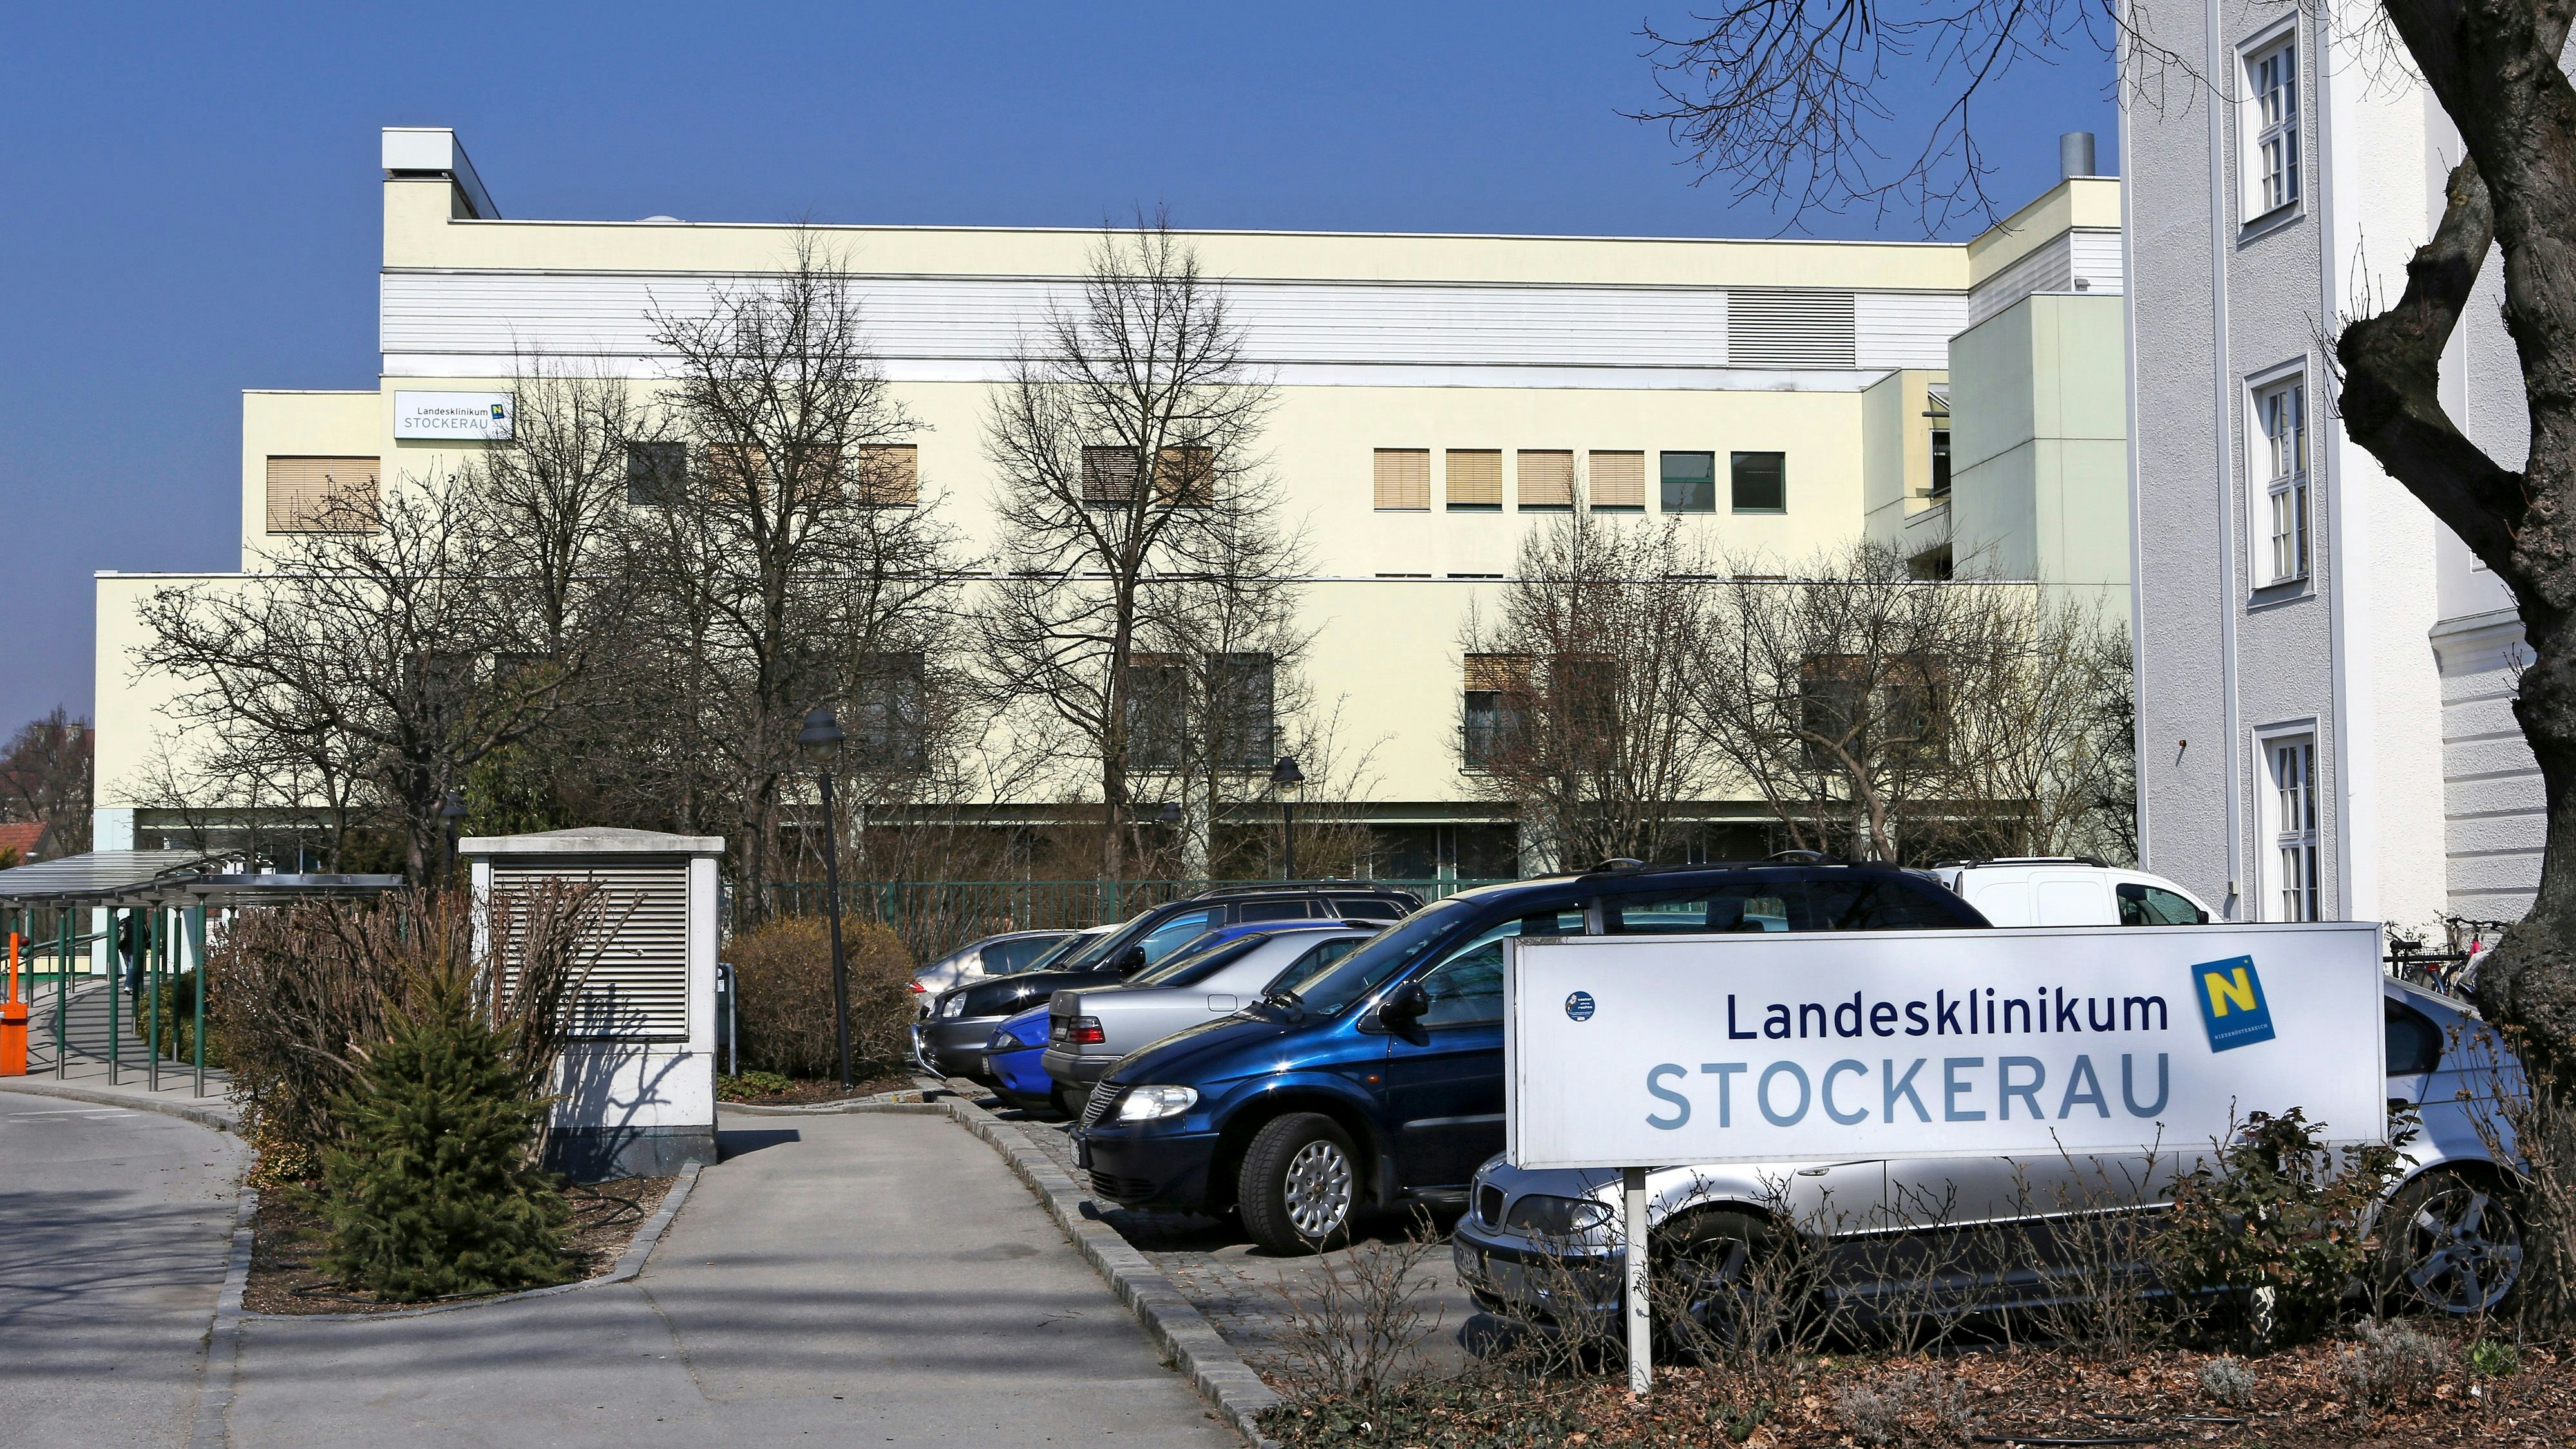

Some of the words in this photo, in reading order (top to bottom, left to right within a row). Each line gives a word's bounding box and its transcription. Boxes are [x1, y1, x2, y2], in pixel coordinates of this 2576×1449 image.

[404, 417, 488, 429] STOCKERAU
[417, 407, 488, 416] Landesklinikum
[2204, 967, 2257, 1018] N
[1727, 987, 2168, 1040] Landesklinikum
[2214, 1023, 2268, 1039] NIEDERÖSTERREICH
[1645, 1052, 2171, 1131] STOCKERAU
